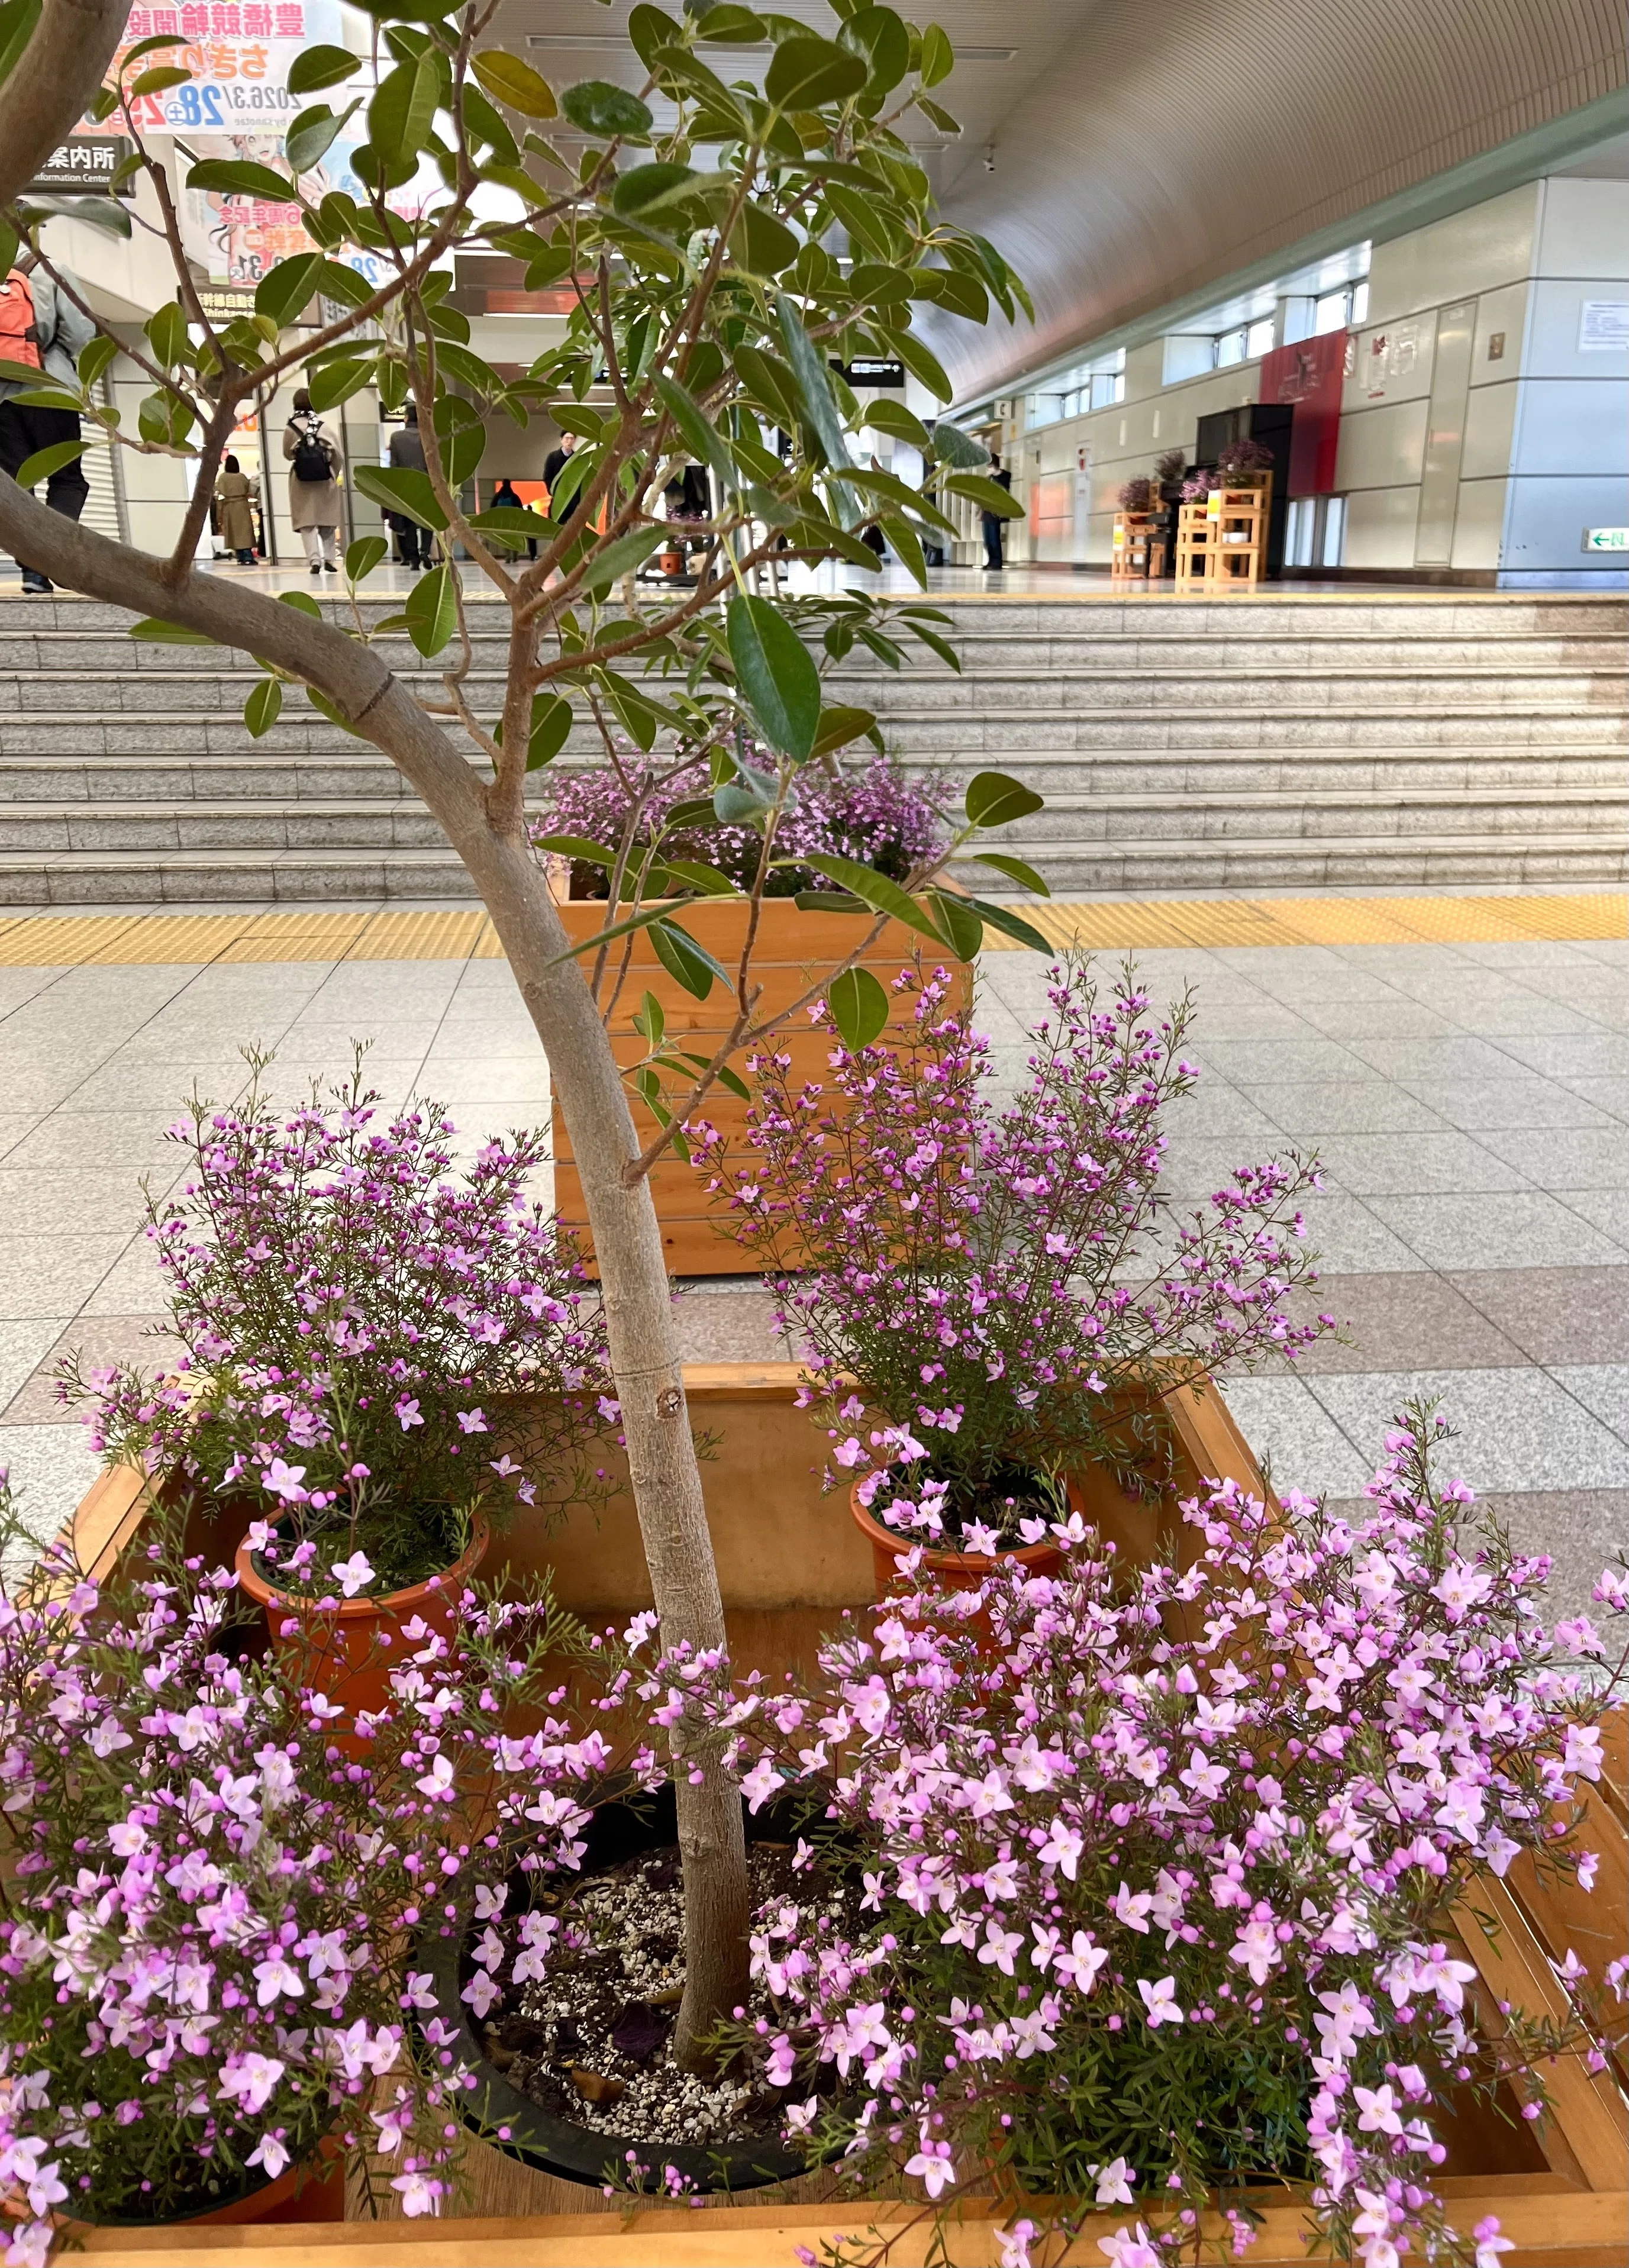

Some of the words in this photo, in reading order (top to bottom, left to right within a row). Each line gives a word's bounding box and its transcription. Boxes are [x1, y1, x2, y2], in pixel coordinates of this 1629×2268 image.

[42, 146, 115, 170] 案内所
[32, 172, 82, 182] nformation
[83, 173, 111, 183] Center
[203, 308, 256, 318] Shinkanse
